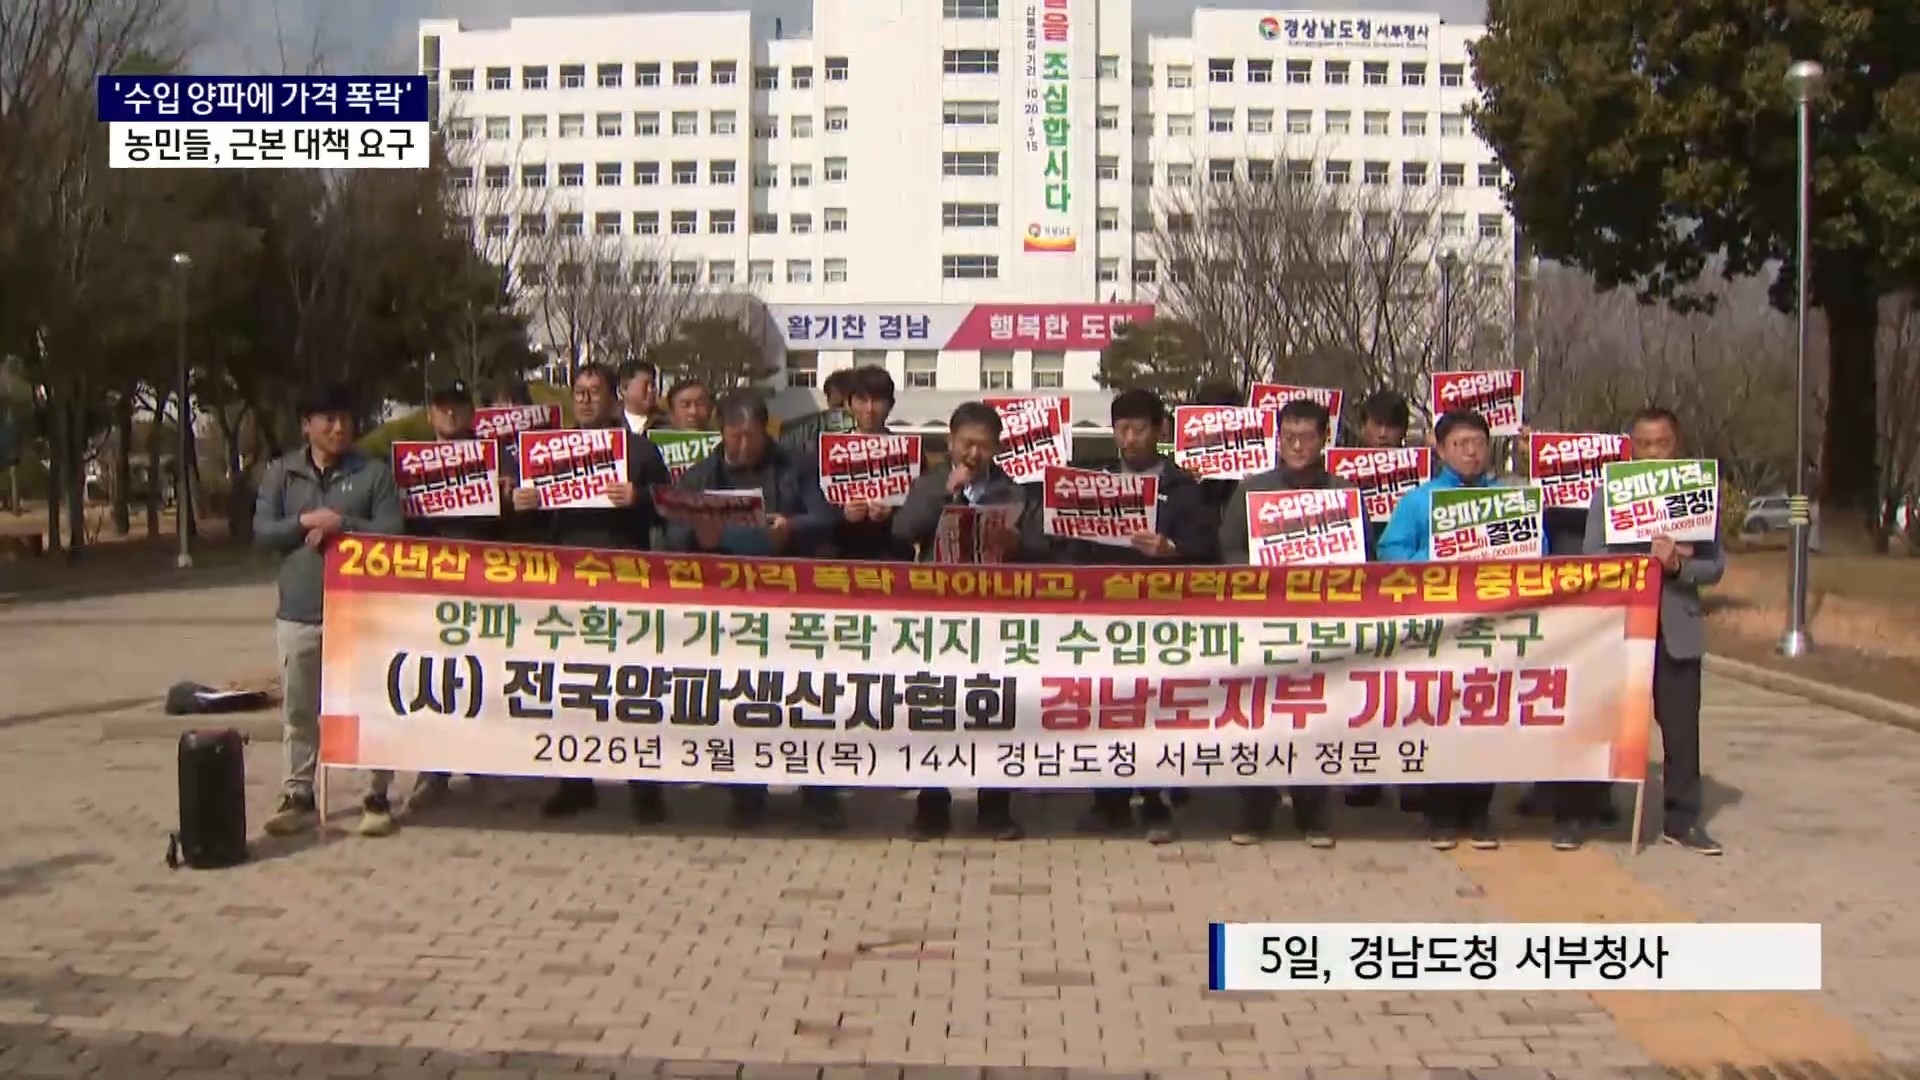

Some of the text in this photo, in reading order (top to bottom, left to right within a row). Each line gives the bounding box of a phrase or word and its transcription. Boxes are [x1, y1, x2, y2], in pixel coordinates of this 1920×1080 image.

[1285, 19, 1372, 40] 경상남도청
[1042, 53, 1071, 213] 조심합시다
[787, 314, 866, 341] 활기찬
[879, 314, 931, 340] 경남
[990, 313, 1069, 340] 행복한
[1441, 370, 1513, 401] 수입양파
[1184, 408, 1265, 437] 수입양파
[402, 441, 486, 475] 수입양파
[529, 431, 613, 464] 수입양파
[829, 435, 909, 464] 수입양파
[1335, 447, 1419, 479] 수입양파
[1539, 436, 1623, 464] 수입양파
[1054, 474, 1145, 498] 수입양파
[1258, 490, 1347, 523] 수입양파
[1664, 489, 1714, 519] 결정!
[1486, 515, 1539, 546] 결정!
[1259, 529, 1358, 565] 마련하라!
[338, 539, 470, 582] 26년산
[483, 548, 560, 585] 양파
[667, 558, 704, 590] 전
[718, 562, 798, 593] 가격
[908, 568, 1088, 603] 막아내고,
[1103, 570, 1268, 602] 살인적인
[1285, 569, 1364, 602] 민간
[1377, 567, 1459, 602] 수입
[1474, 558, 1648, 601] 중단하라!
[436, 600, 1544, 666] 양파 수확기 가격 폭락 저지 및 수입양파 근본대책 촉구
[386, 650, 1569, 732] (사) 전국양파생산자협회 경남도지부 기자회견
[534, 734, 1429, 778] 2026년 3월 5일(목) 14시 경남도청 서부청사 정문 앞
